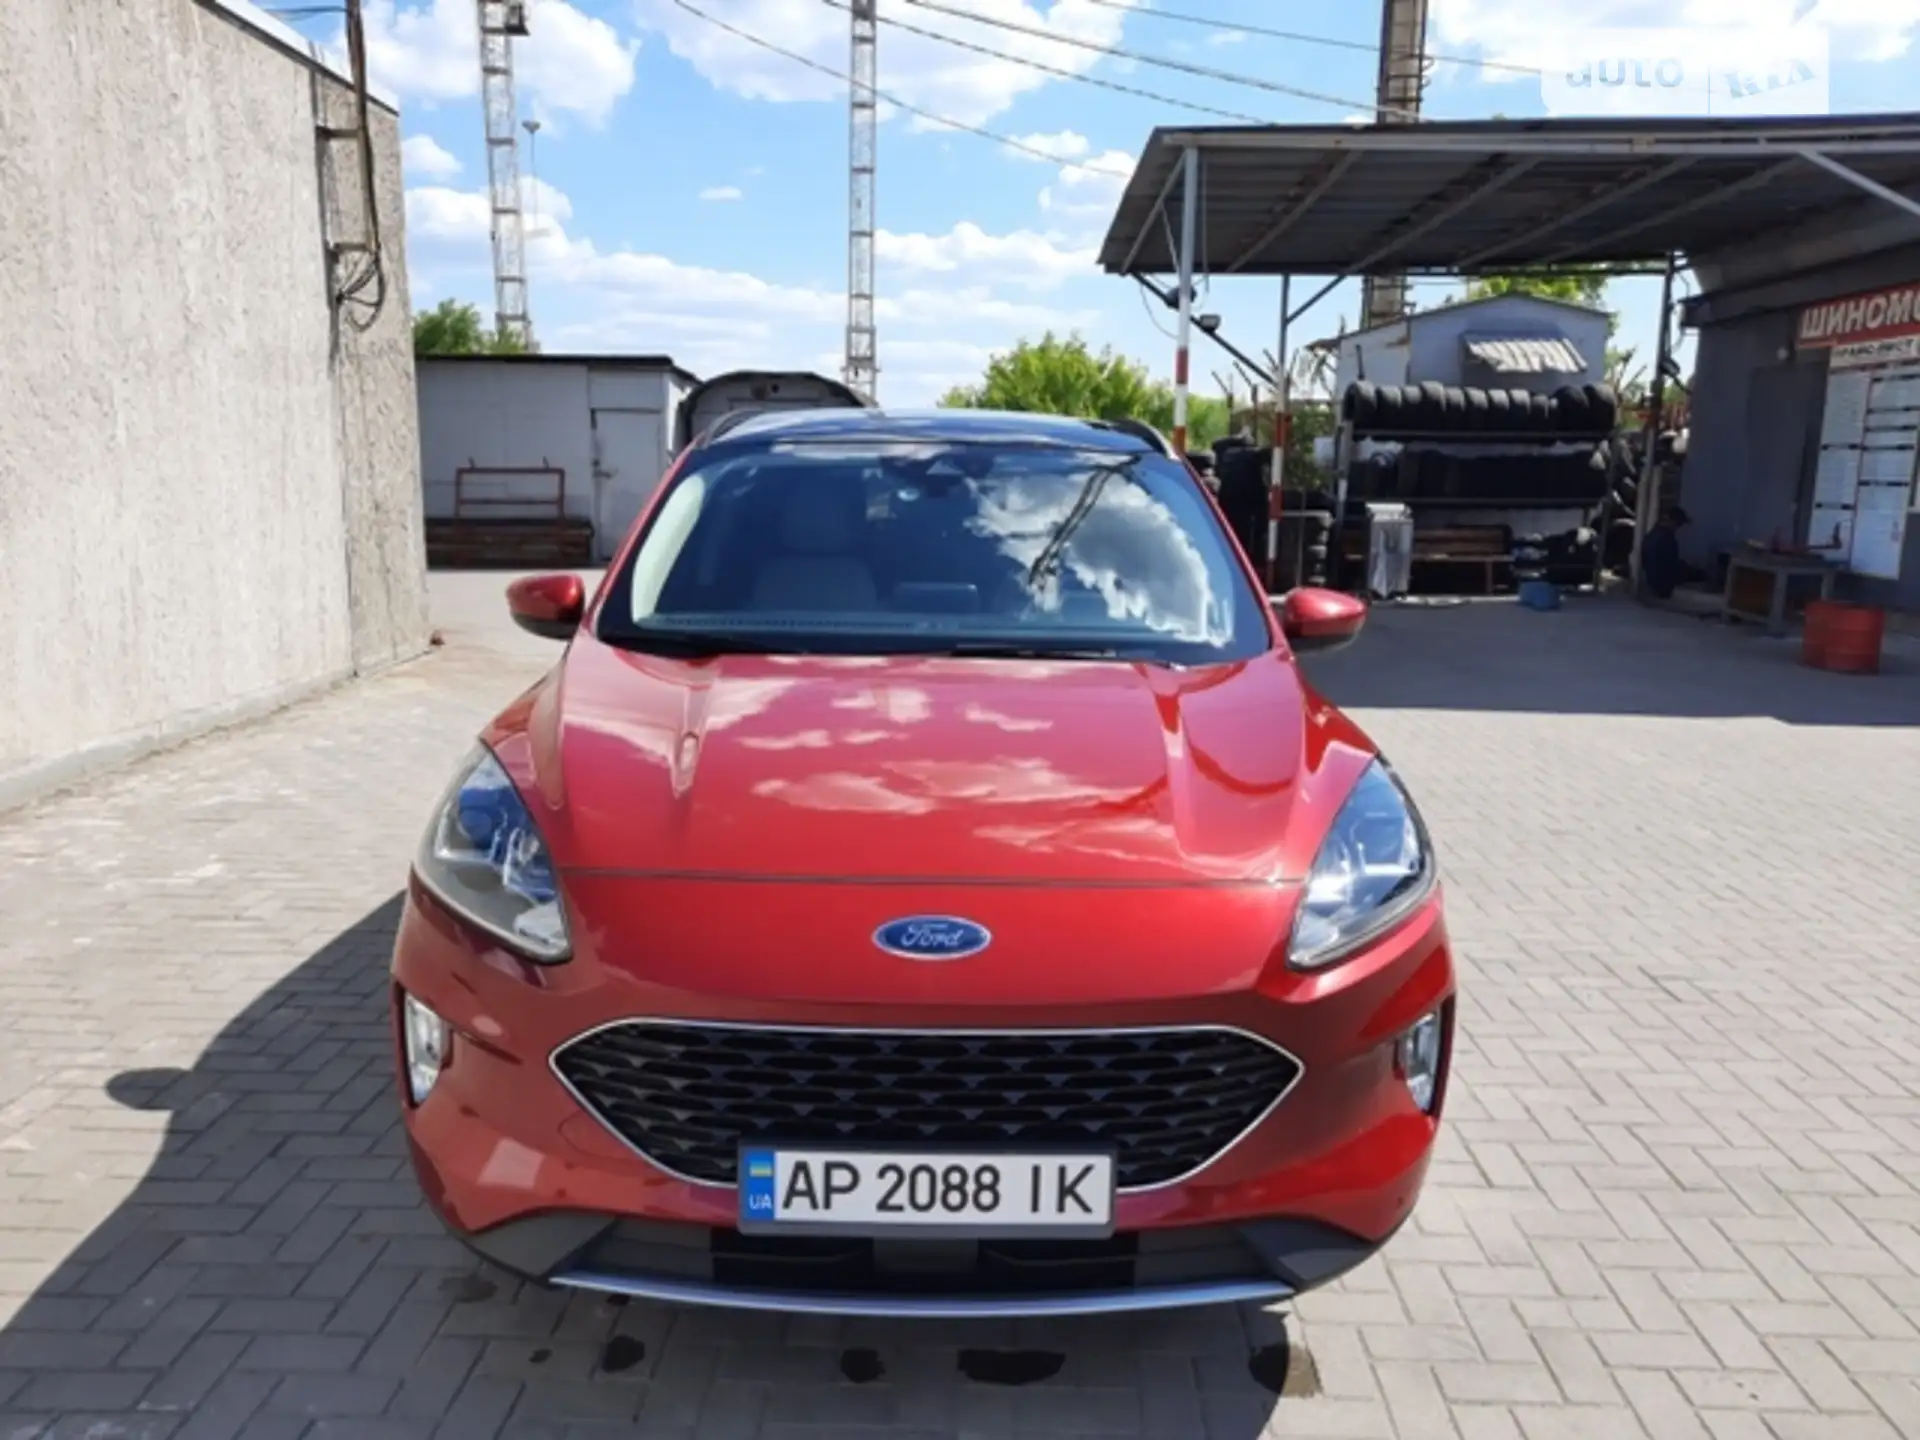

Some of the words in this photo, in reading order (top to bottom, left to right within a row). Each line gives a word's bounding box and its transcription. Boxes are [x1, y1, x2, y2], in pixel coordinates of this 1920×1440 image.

[901, 922, 964, 948] Ford
[782, 1160, 861, 1210] AP
[875, 1163, 1001, 1213] 2088
[1030, 1164, 1095, 1213] IK
[749, 1193, 772, 1210] UA
